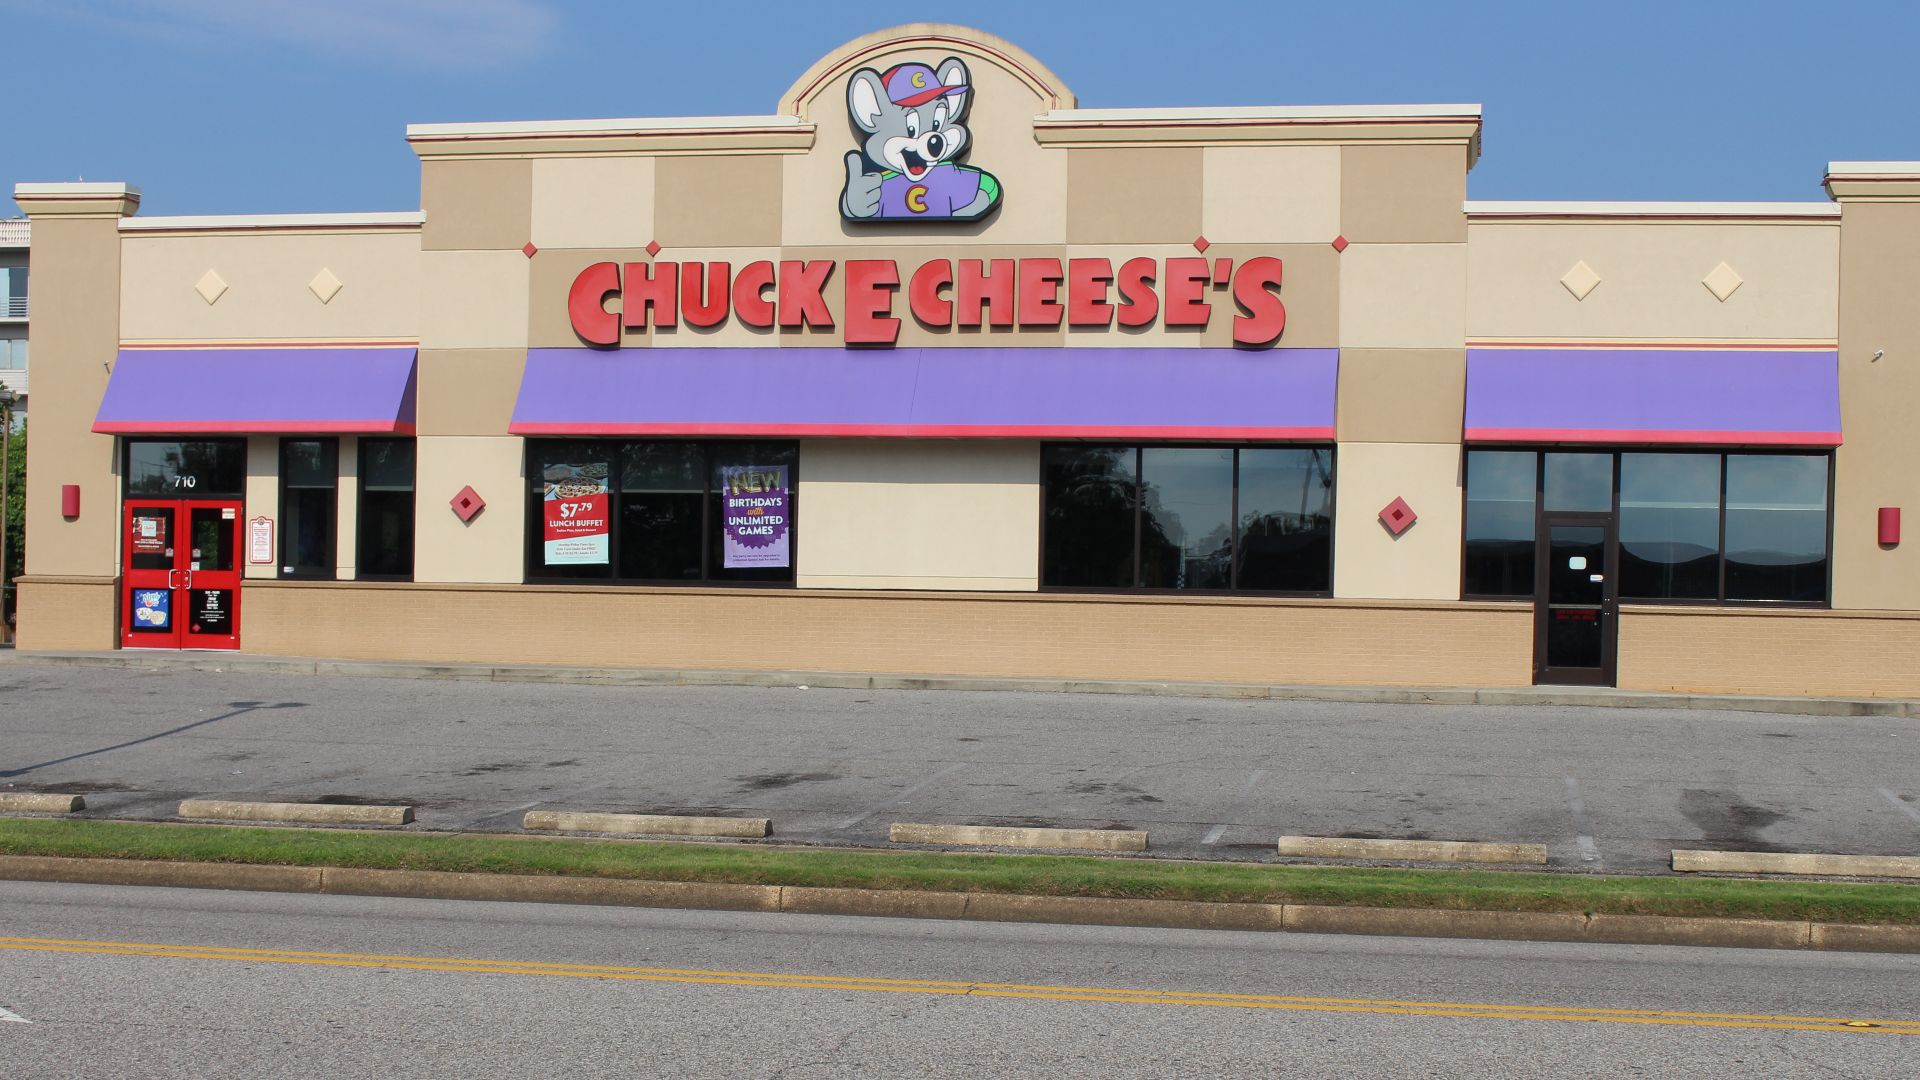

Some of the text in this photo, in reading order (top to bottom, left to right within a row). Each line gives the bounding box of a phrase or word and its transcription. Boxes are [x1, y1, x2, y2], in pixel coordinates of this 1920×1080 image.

[905, 184, 930, 214] C
[568, 256, 1287, 346] CHUCK E CHEESE'S
[174, 475, 196, 488] 710
[729, 471, 781, 496] NEW
[729, 497, 783, 508] BIRTHDAYS
[560, 502, 593, 519] $7.79
[747, 507, 765, 516] with
[549, 519, 604, 528] LUNCH BUFFET
[728, 515, 784, 526] UNLIMITED
[738, 526, 774, 536] GAMES
